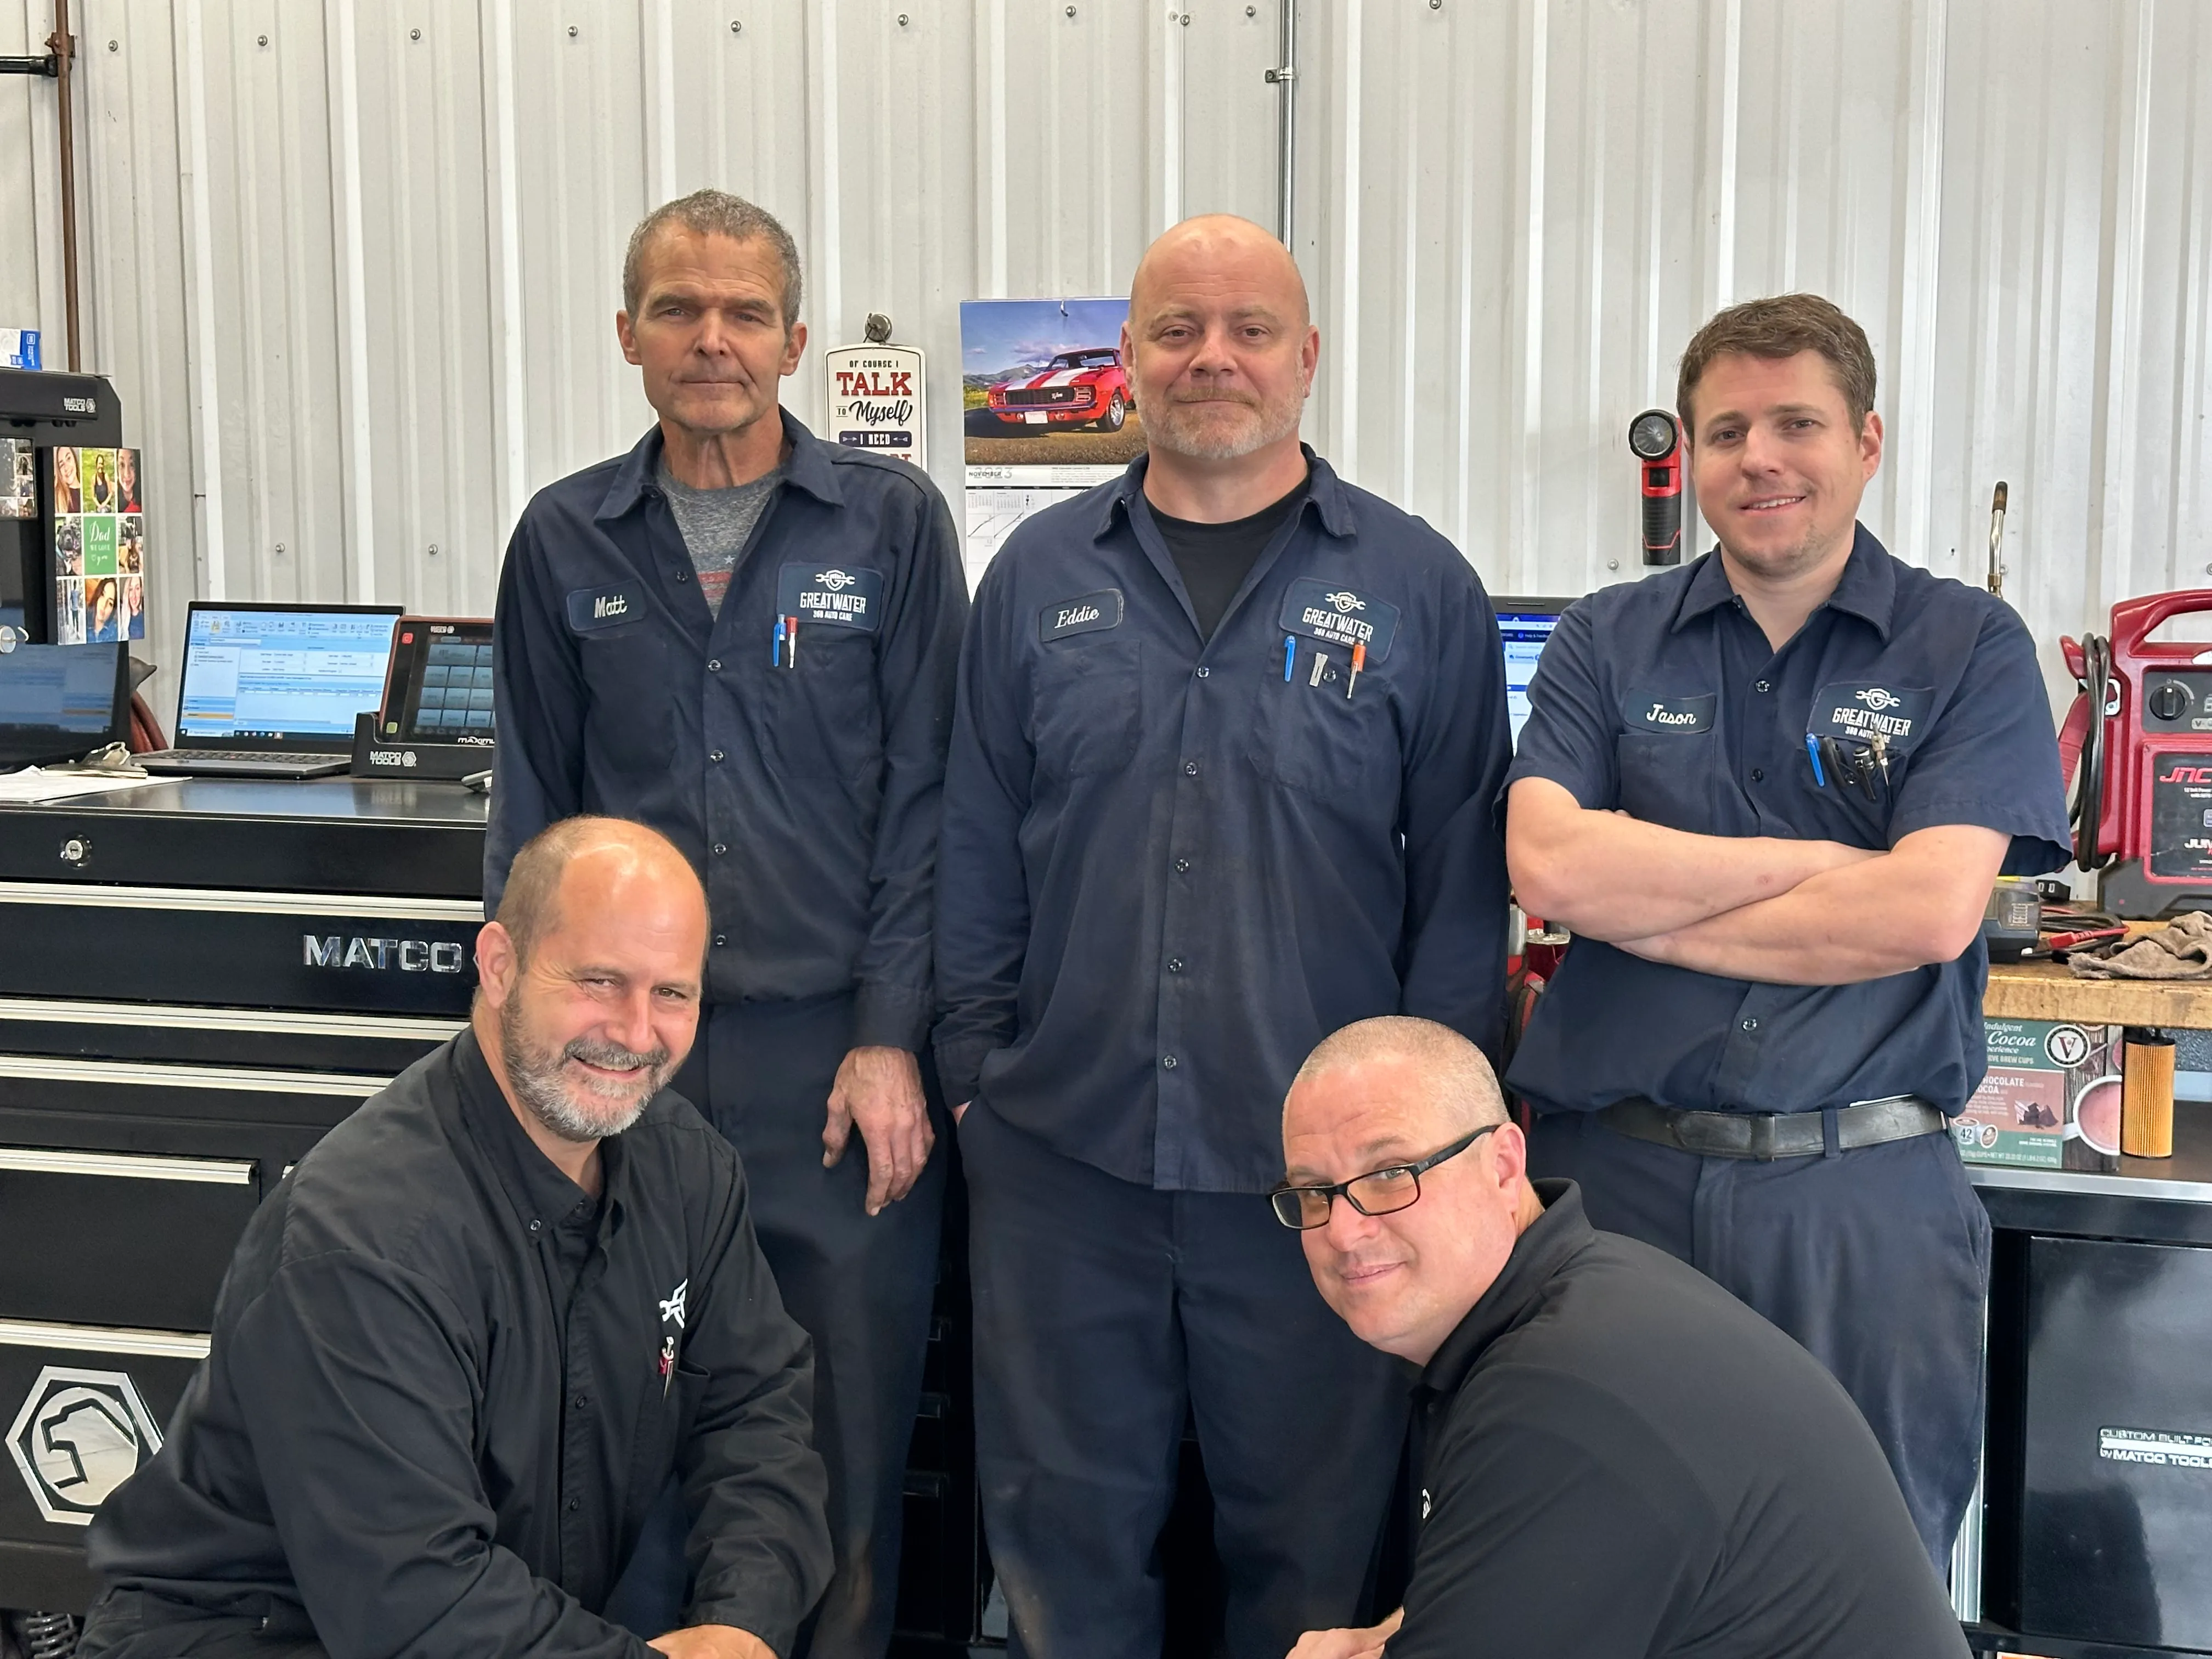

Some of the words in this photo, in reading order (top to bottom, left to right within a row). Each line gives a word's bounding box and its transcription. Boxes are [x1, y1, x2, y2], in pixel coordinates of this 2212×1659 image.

[836, 372, 912, 396] TALK
[848, 400, 913, 426] Myself
[860, 433, 864, 445] I
[868, 433, 890, 445] NEED
[89, 521, 110, 543] Dad
[594, 595, 628, 618] Matt
[800, 592, 867, 614] GREATWATER
[825, 611, 838, 620] AUTO
[839, 612, 853, 621] CARE
[1054, 606, 1100, 629] Eddie
[1302, 607, 1374, 642] GREATWATER
[1325, 630, 1339, 640] AUTO
[1340, 635, 1356, 645] CARE
[1646, 703, 1696, 724] Jason
[1832, 707, 1912, 736] GREATWATER
[370, 751, 402, 760] MATCO
[371, 758, 402, 766] TOOLS
[303, 934, 462, 973] MATCO
[1988, 1030, 2036, 1047] Cocoa
[2058, 1036, 2078, 1059] V
[1987, 1046, 2019, 1054] perience
[1978, 1085, 2000, 1094] OCOA
[1983, 1076, 2025, 1087] HOCOLATE
[1961, 1128, 1972, 1139] 42
[2100, 1429, 2155, 1441] CUSTOM
[2194, 1436, 2212, 1447] FO
[2113, 1449, 2166, 1464] MATCO
